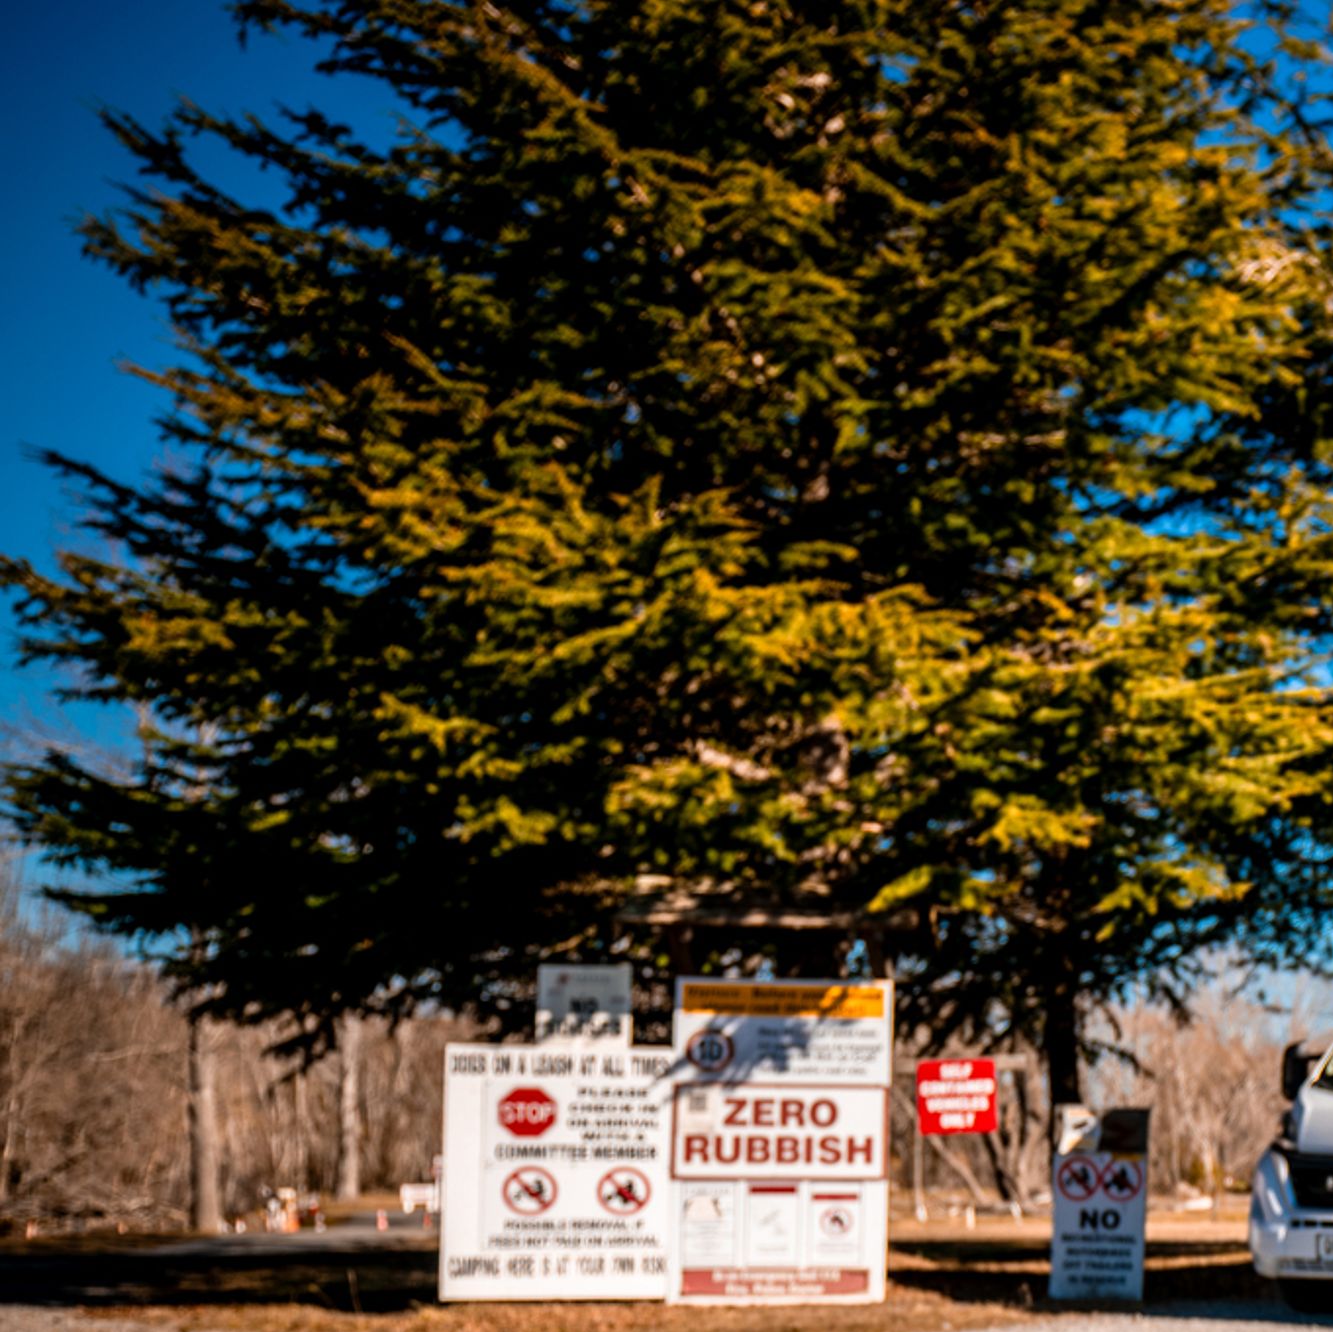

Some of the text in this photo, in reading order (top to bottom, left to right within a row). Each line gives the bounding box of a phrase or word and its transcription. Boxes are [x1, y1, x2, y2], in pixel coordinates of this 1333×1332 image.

[493, 1054, 511, 1075] ON
[532, 1054, 573, 1077] LEASH
[581, 1055, 596, 1076] AT
[602, 1056, 624, 1076] ALL
[500, 1102, 557, 1125] STOP
[723, 1097, 838, 1128] ZERO
[494, 1144, 588, 1160] COMMITTEE
[684, 1134, 873, 1165] RUBBISH
[1079, 1208, 1121, 1230] NO
